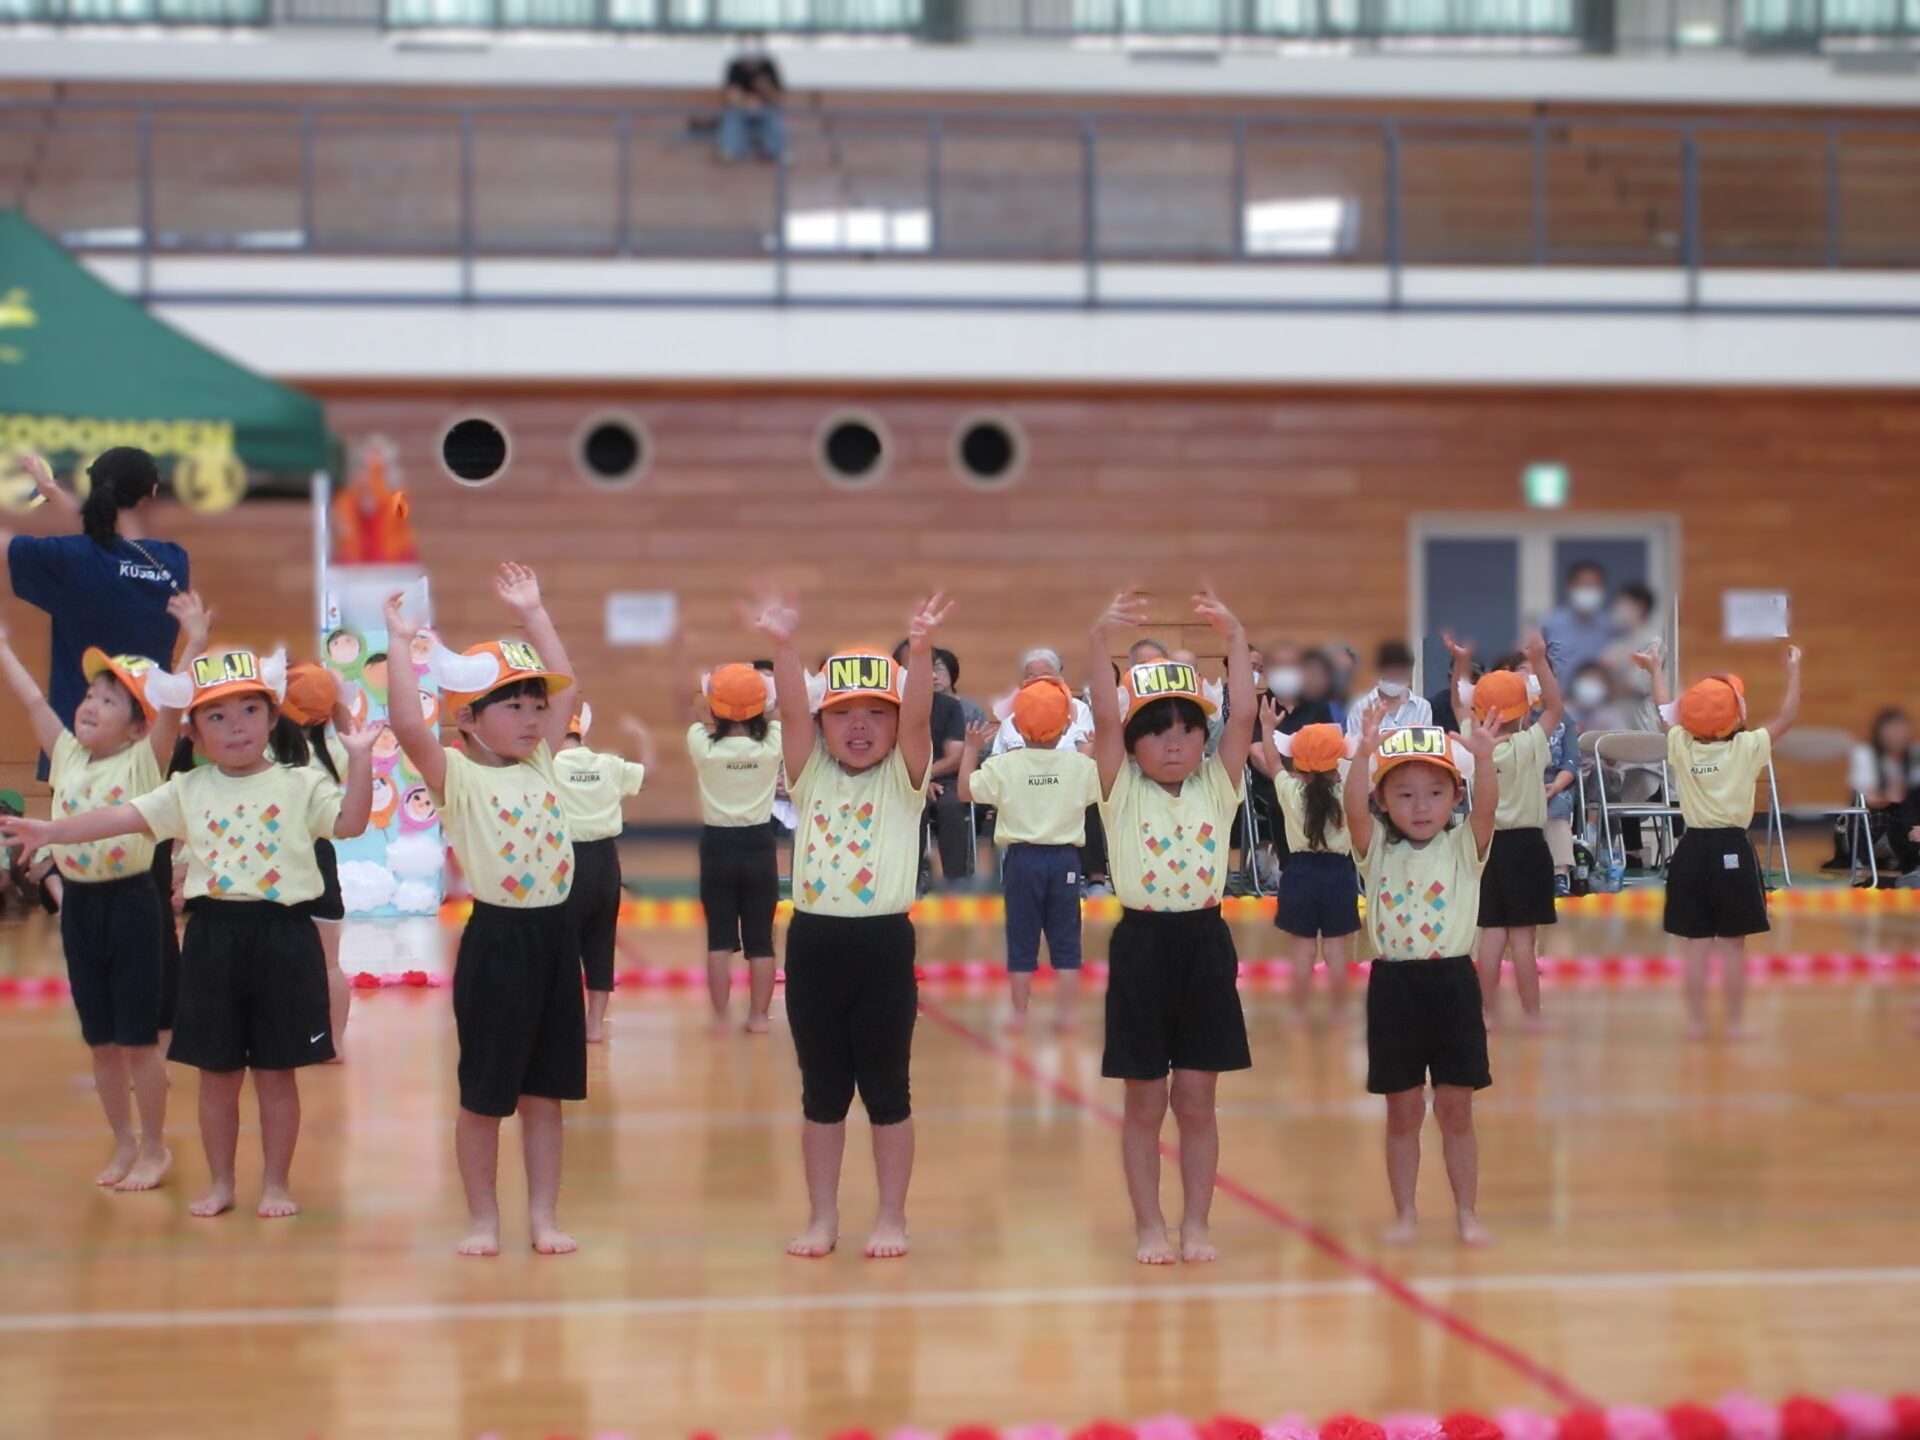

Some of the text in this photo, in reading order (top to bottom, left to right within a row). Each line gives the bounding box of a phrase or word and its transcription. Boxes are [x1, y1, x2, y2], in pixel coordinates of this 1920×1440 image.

[832, 659, 887, 688] NIJI
[1135, 666, 1195, 694] NIJI
[1028, 777, 1059, 786] KUJIRA
